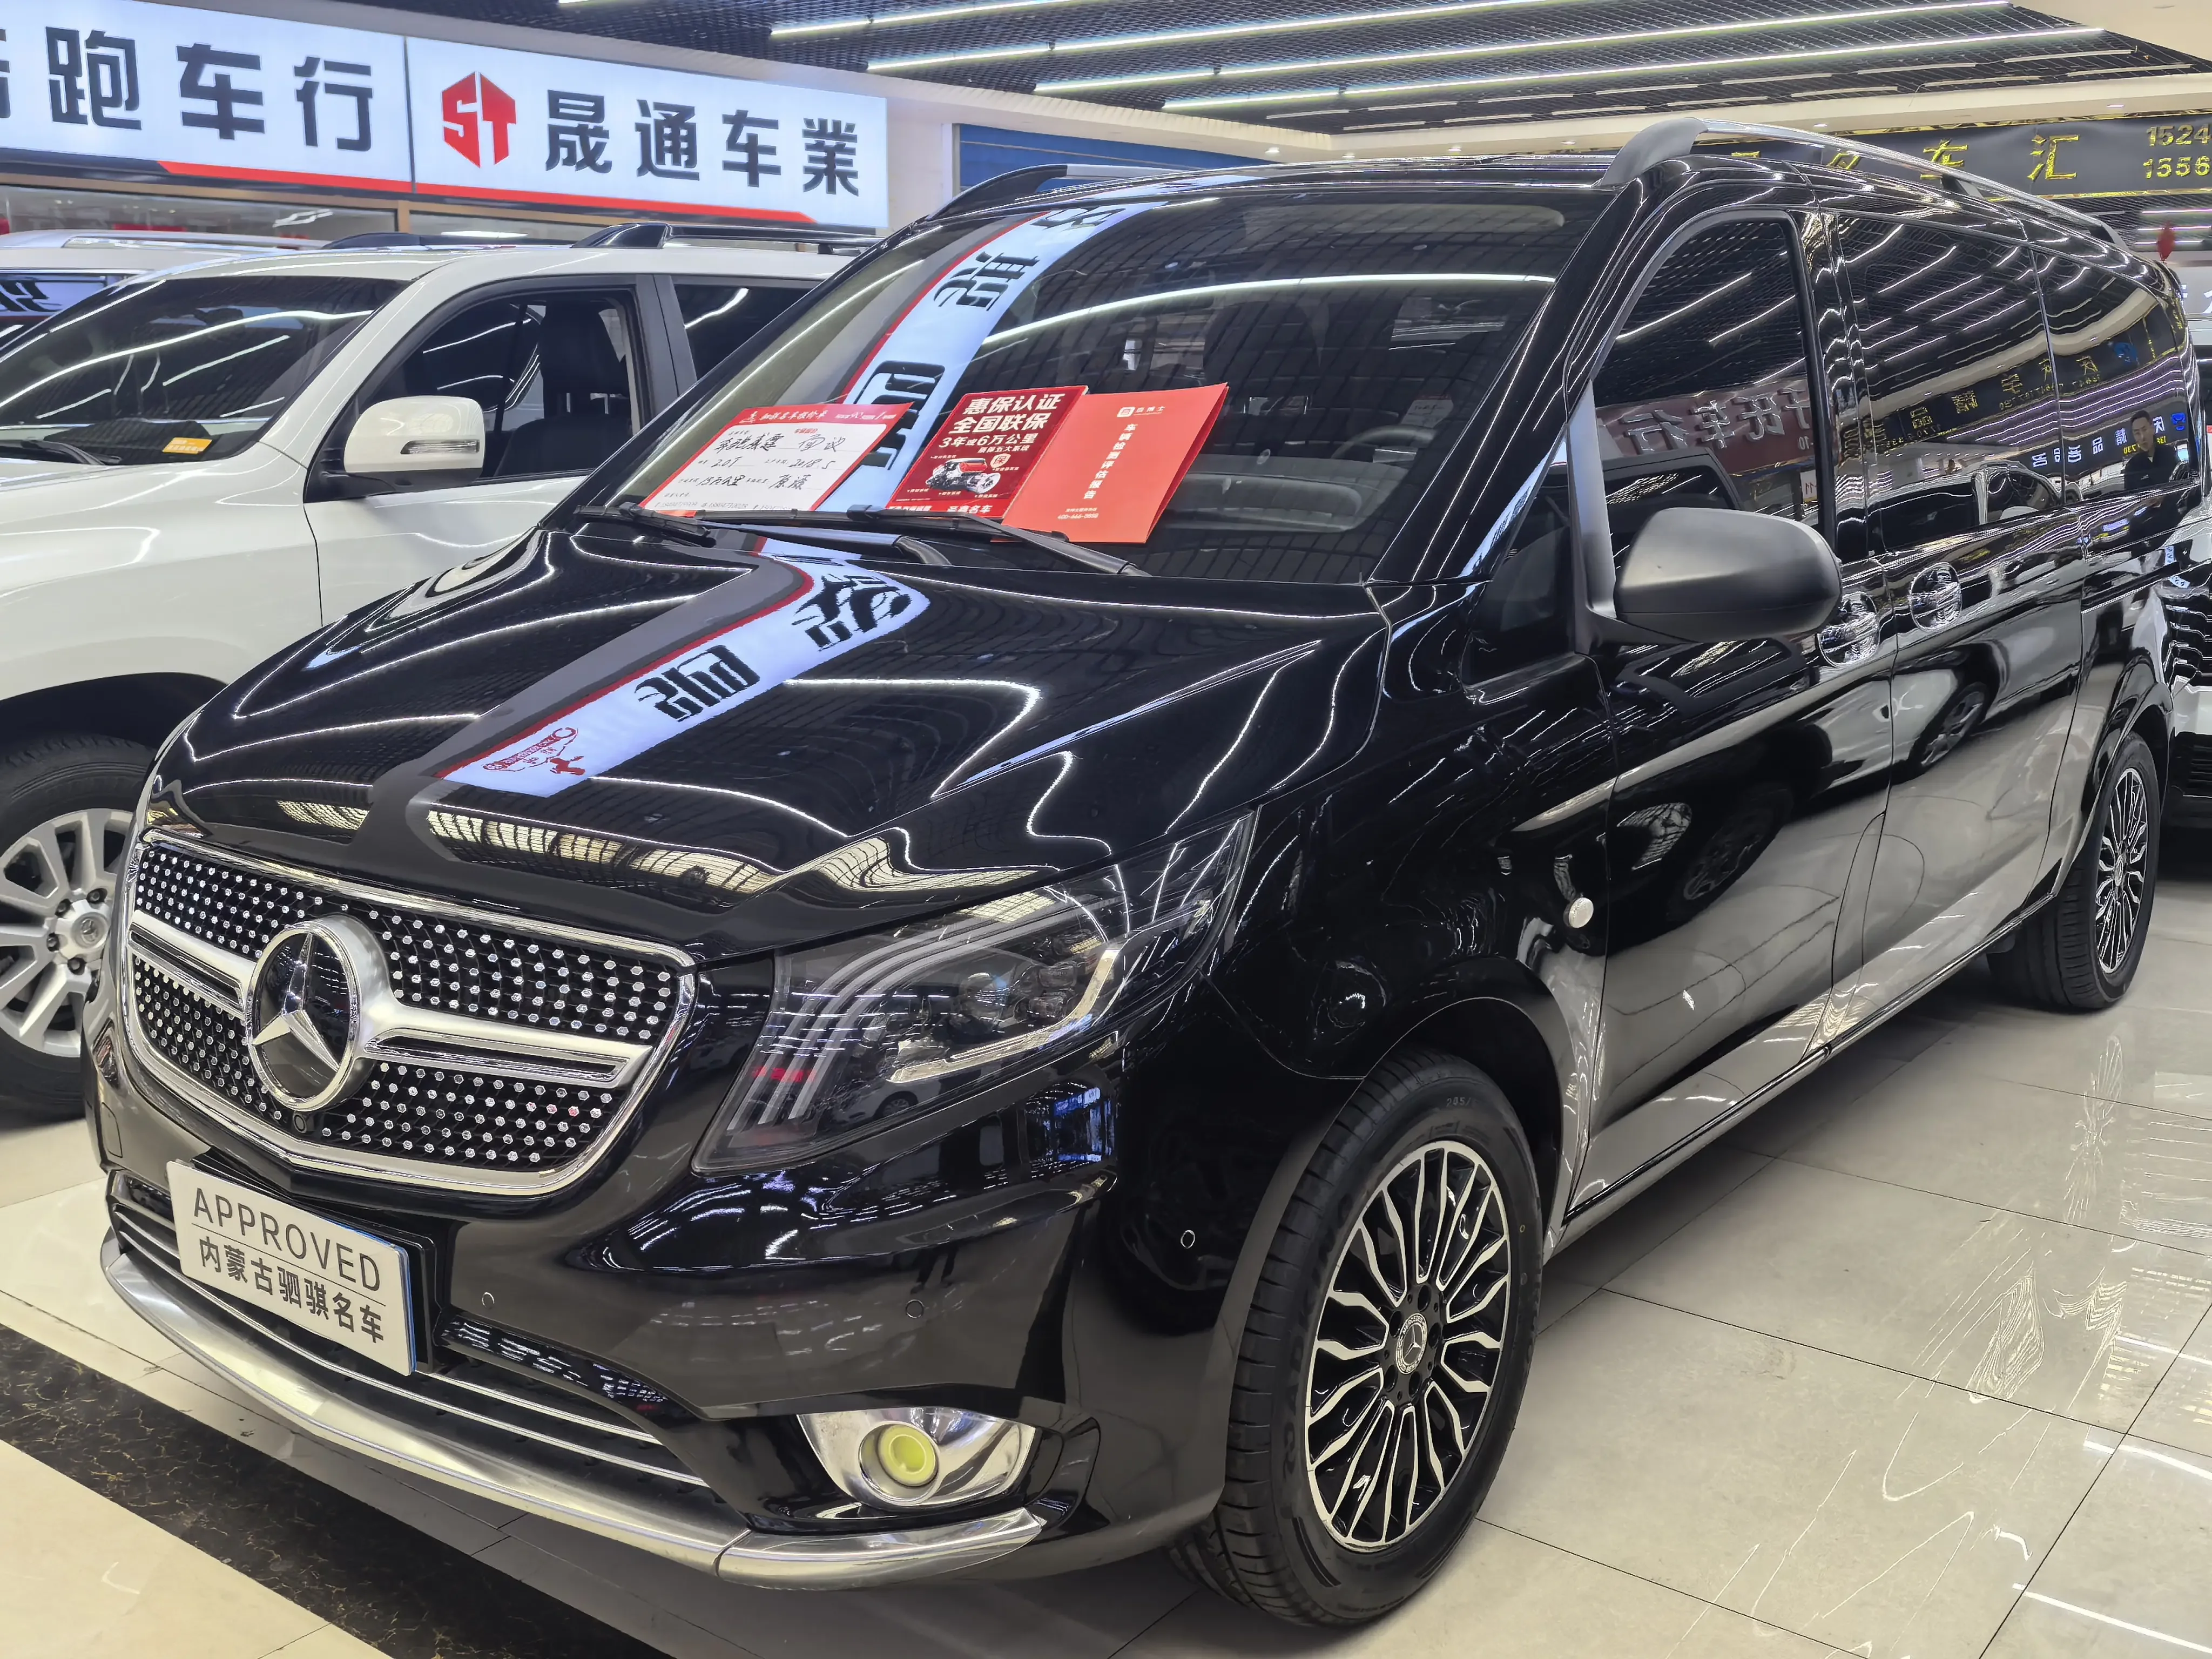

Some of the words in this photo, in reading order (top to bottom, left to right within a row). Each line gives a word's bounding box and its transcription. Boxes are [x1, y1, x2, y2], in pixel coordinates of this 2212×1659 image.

[0, 26, 373, 152] 跑车行
[546, 90, 860, 197] 晟通车業
[2142, 154, 2210, 179] 1556
[949, 414, 1049, 433] 全国联保
[963, 393, 1065, 415] 惠保认证
[193, 1187, 381, 1292] APPROVED
[199, 1236, 384, 1344] 内蒙古驷骐名车
